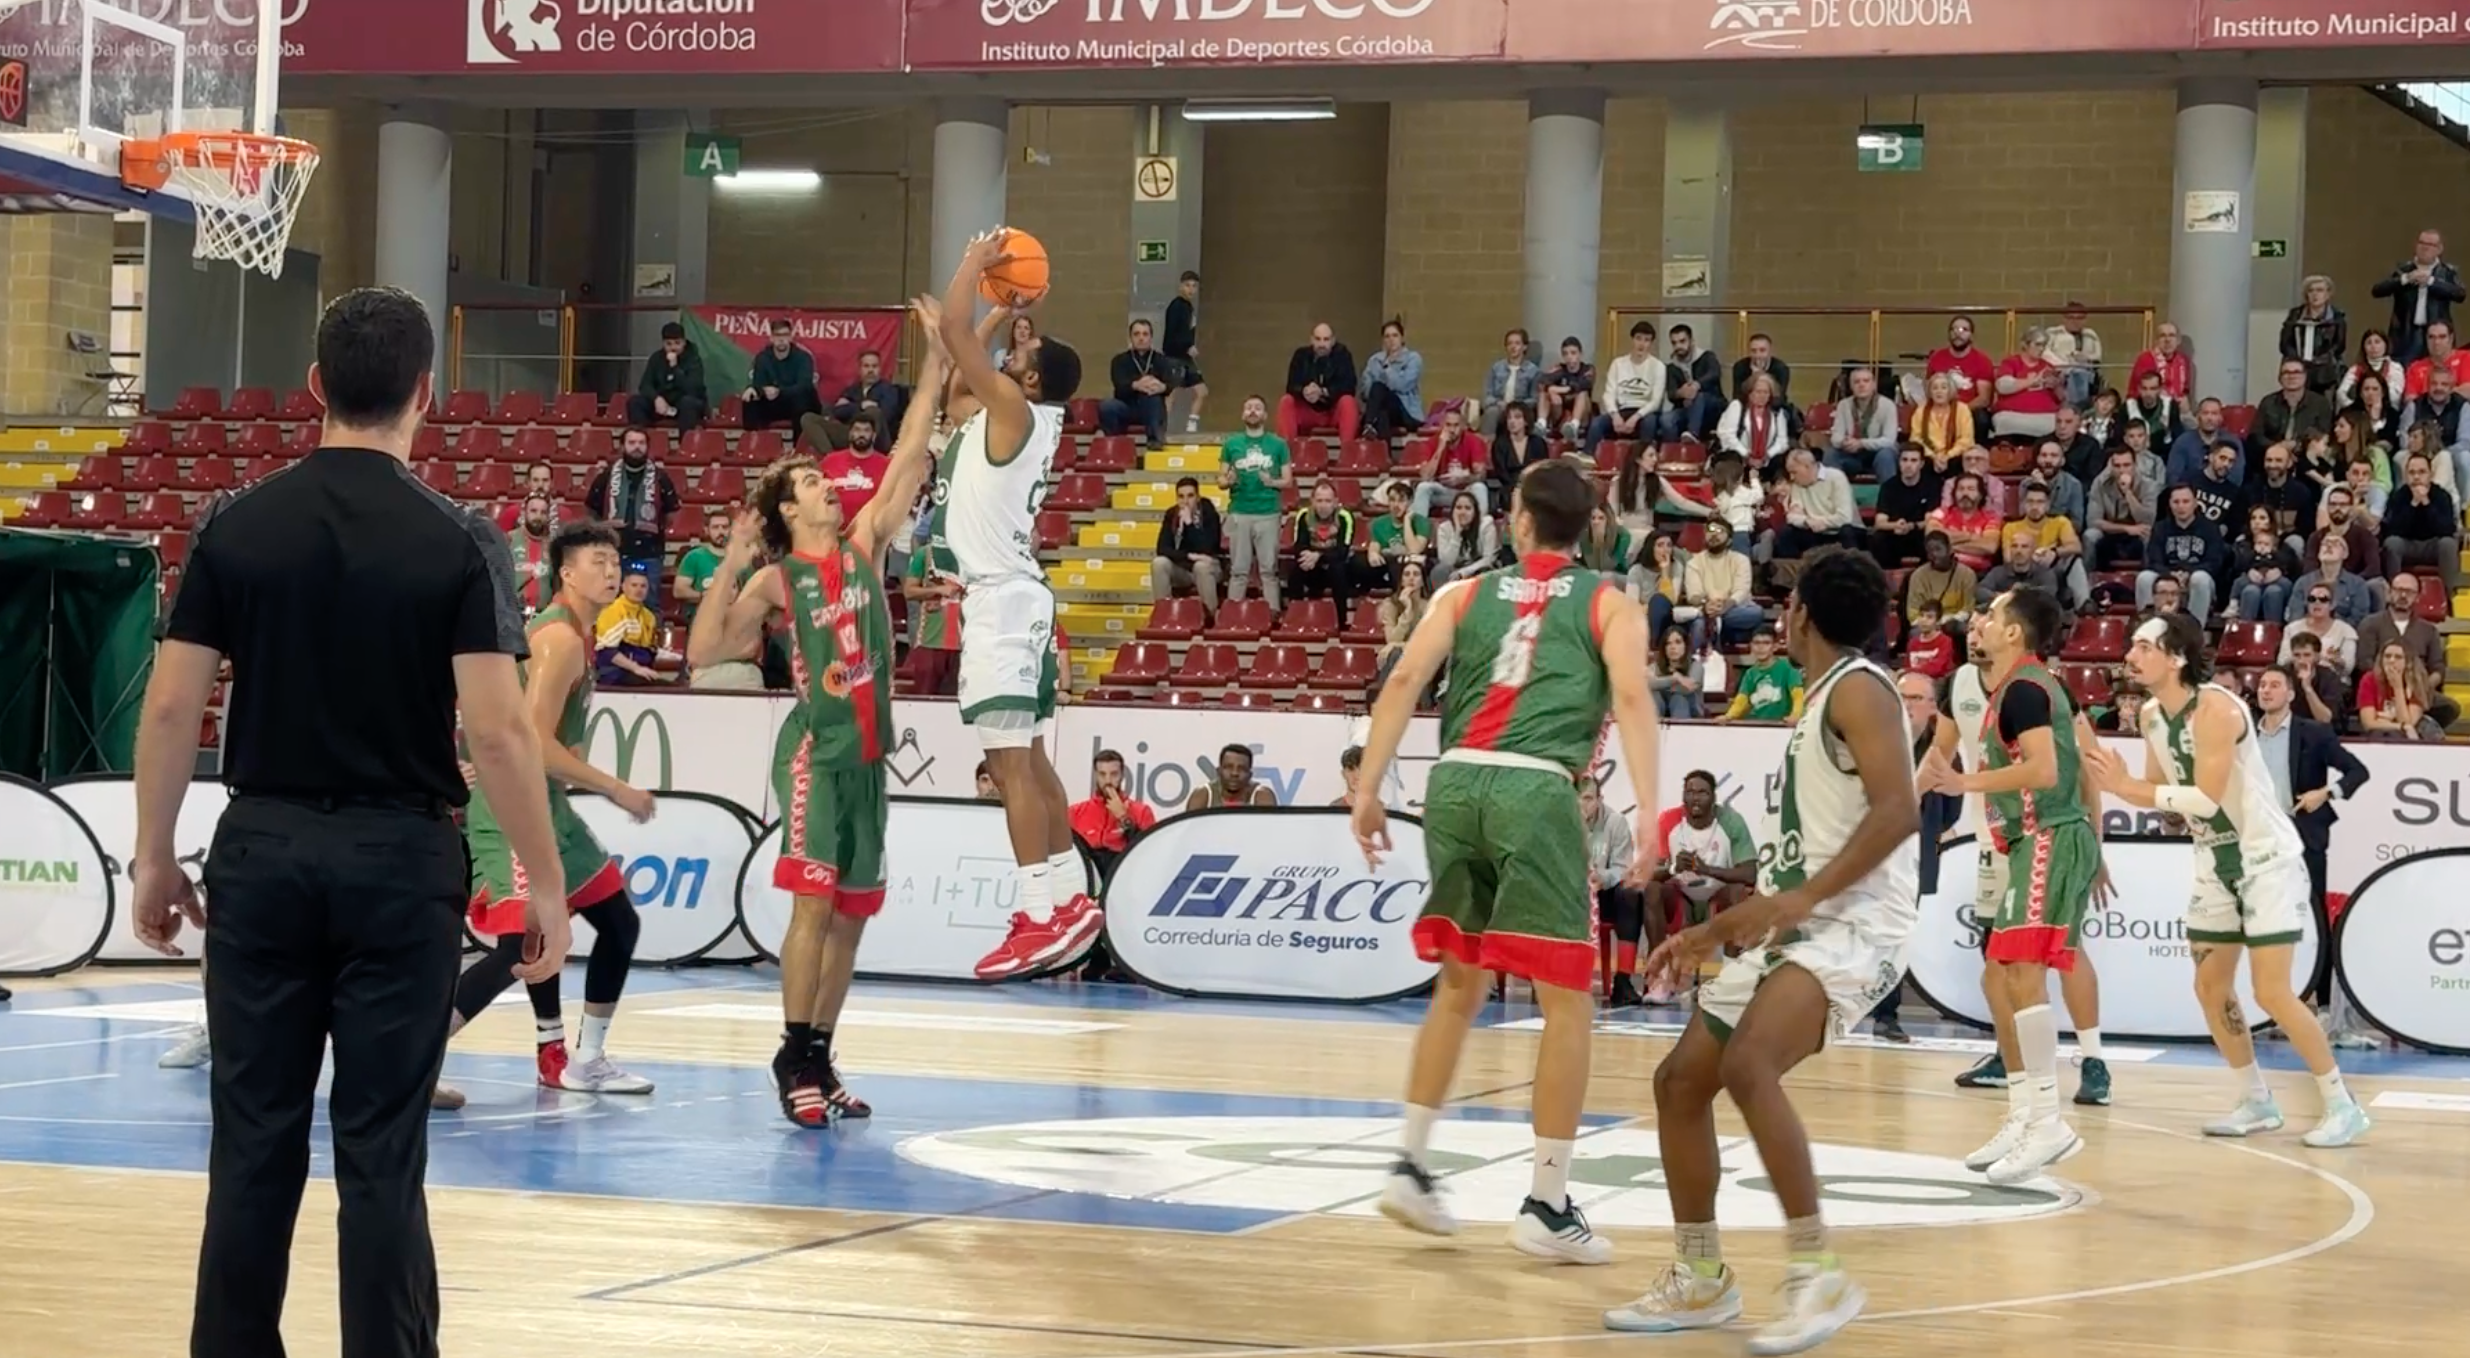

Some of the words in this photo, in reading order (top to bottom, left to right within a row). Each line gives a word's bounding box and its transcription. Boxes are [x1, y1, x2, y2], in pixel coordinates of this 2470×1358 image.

[577, 23, 615, 51] de
[626, 21, 756, 51] Córdoba
[2213, 16, 2320, 38] Instituto
[2326, 11, 2457, 39] Municipal
[32, 39, 119, 58] Municpal
[150, 40, 229, 58] Deortes
[234, 39, 306, 57] Cóoba
[981, 40, 1070, 62] Instituto
[1076, 38, 1185, 64] Municipal
[1191, 37, 1221, 58] de
[1226, 37, 1331, 59] Deportes
[1336, 35, 1434, 56] Córdoba
[700, 141, 724, 171] A
[1877, 132, 1904, 164] B
[714, 311, 773, 337] PEÑA
[788, 317, 868, 341] AJISTA
[1272, 865, 1340, 878] GRUPO
[1236, 878, 1430, 924] PACC
[2082, 910, 2188, 942] oBout
[1256, 929, 1284, 948] de
[1289, 931, 1380, 953] Seguros
[2148, 944, 2190, 958] HOTE
